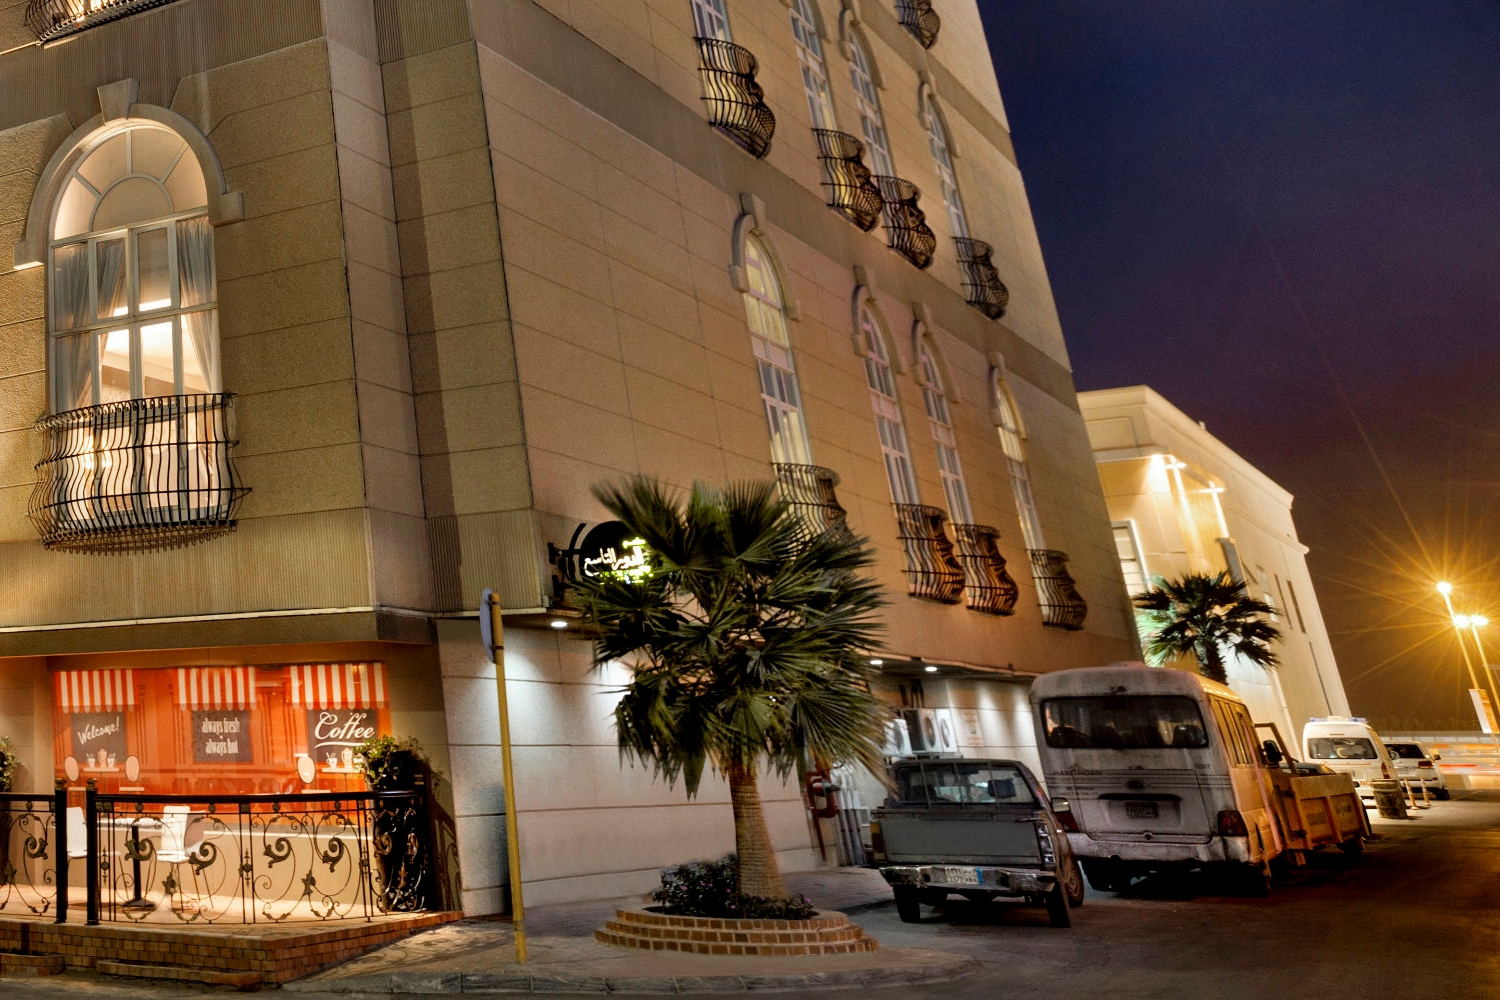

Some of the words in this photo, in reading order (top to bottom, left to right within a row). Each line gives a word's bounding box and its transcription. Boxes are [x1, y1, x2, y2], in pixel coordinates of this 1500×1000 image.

[76, 716, 120, 745] Welcome!
[201, 717, 223, 735] always
[223, 717, 240, 733] fresh
[315, 712, 375, 740] Coffee
[205, 738, 227, 756] always
[227, 738, 239, 754] hot
